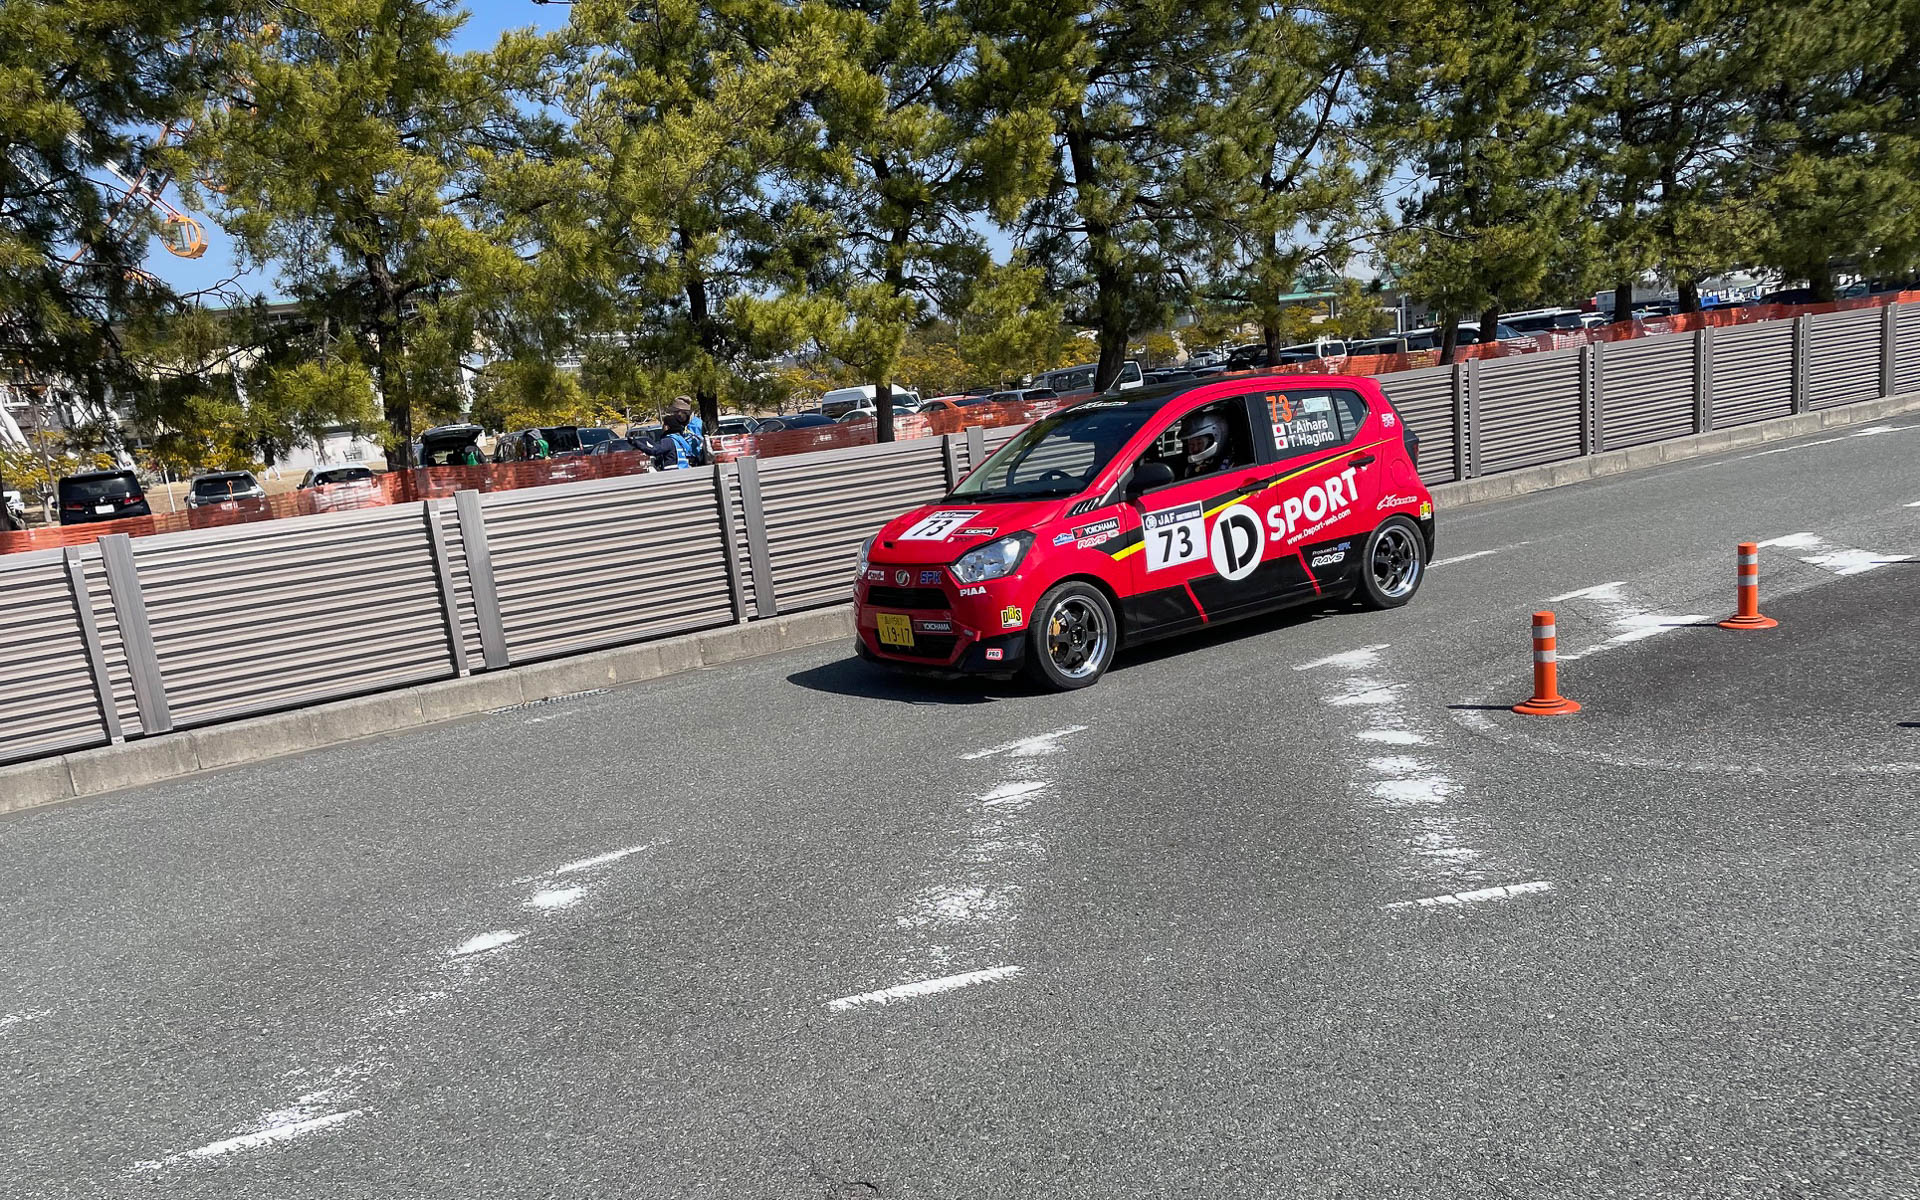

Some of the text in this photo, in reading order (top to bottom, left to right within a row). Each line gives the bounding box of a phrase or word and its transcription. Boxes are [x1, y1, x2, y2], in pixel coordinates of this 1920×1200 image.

[1265, 394, 1292, 423] 73
[1285, 419, 1328, 434] T.Aihara
[1288, 431, 1335, 447] T.Hagino
[1158, 512, 1176, 525] JAF
[1219, 467, 1358, 574] D SPORT
[912, 519, 953, 536] 73
[1084, 520, 1117, 535] YOKOHAMA
[1077, 534, 1108, 549] RAYS
[1158, 526, 1193, 563] 73
[1311, 551, 1345, 567] RAYS
[920, 571, 942, 584] SPK
[959, 585, 987, 597] PIAA
[923, 622, 950, 631] YOKOHAMA
